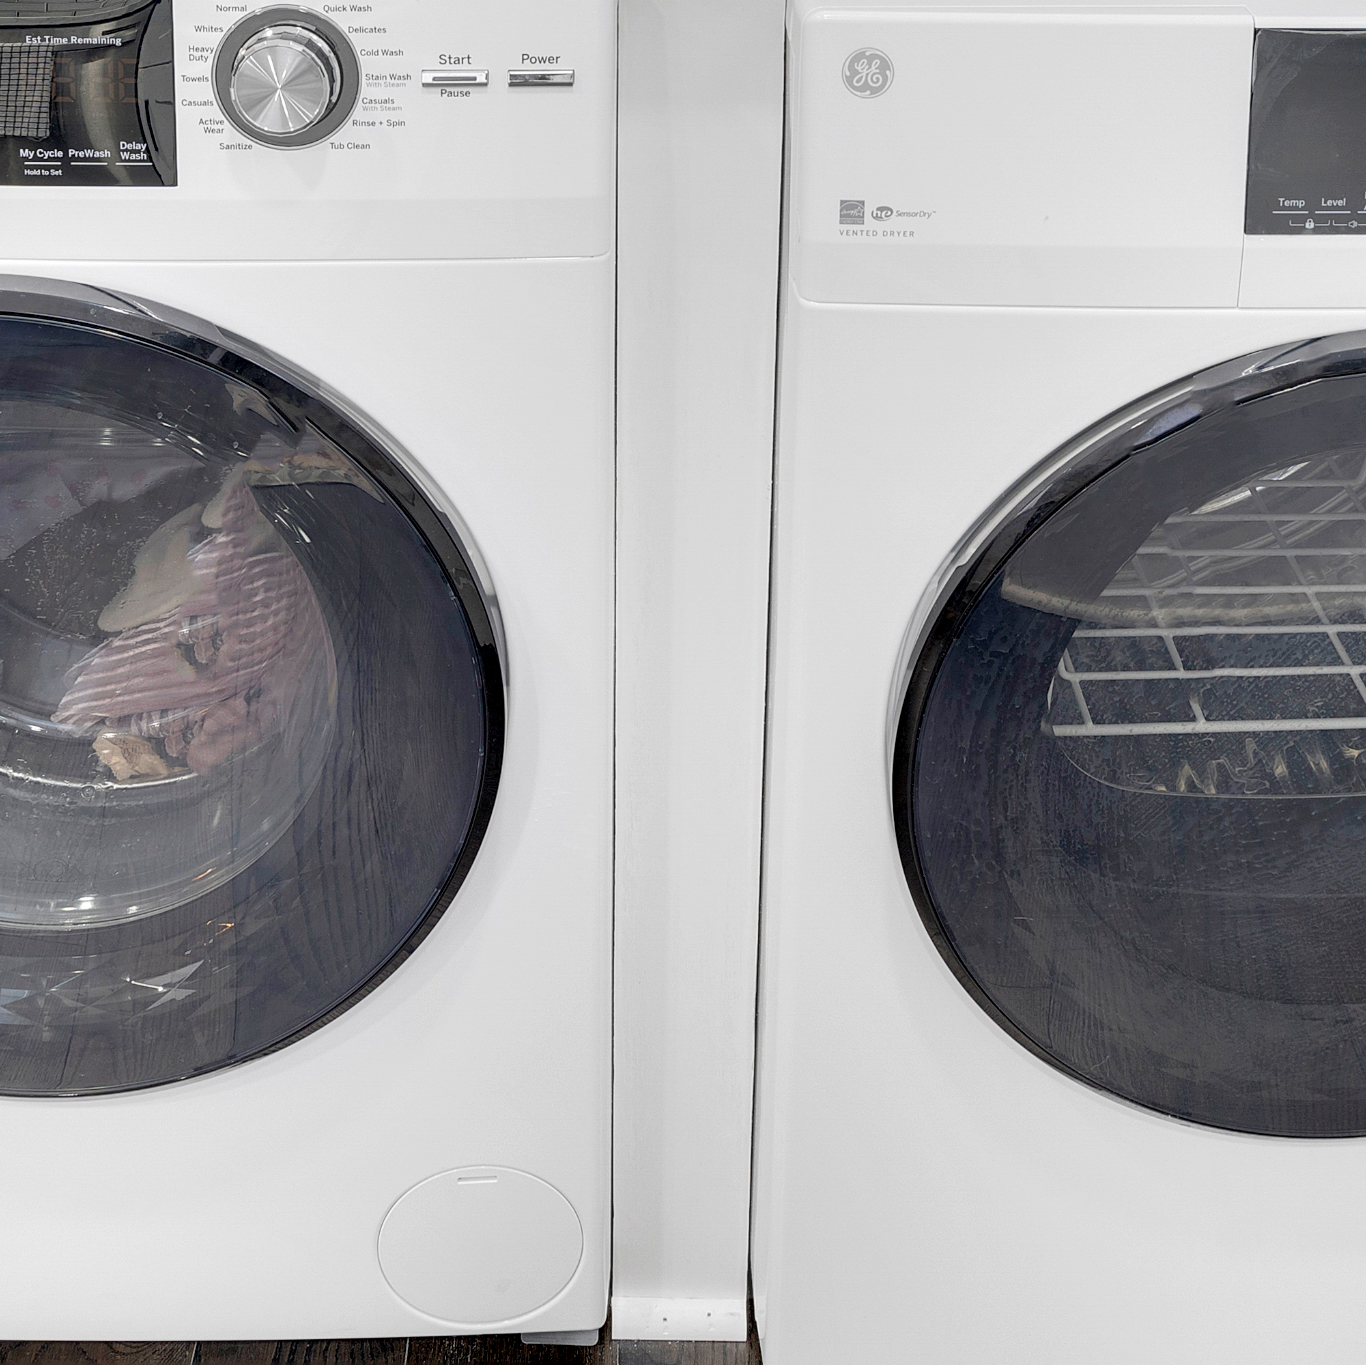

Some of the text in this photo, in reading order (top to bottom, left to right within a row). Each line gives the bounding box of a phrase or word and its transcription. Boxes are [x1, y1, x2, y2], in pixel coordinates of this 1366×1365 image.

[323, 5, 347, 13] Quick
[348, 26, 386, 34] Delicates
[44, 36, 68, 44] Time
[71, 36, 122, 46] Remaining
[189, 46, 214, 54] Heavy
[189, 54, 209, 63] Duty
[439, 54, 472, 65] Start
[522, 54, 560, 64] Power
[441, 89, 470, 97] Pause
[181, 99, 214, 107] Casuals
[362, 97, 395, 105] Casuals
[386, 119, 405, 128] Spin
[120, 141, 147, 151] Delay
[20, 149, 63, 159] My Cycle
[69, 149, 111, 158] PreWash
[121, 151, 147, 160] Wash
[1278, 198, 1305, 208] Temp
[1322, 198, 1346, 206] Level
[895, 210, 932, 219] SensorDry
